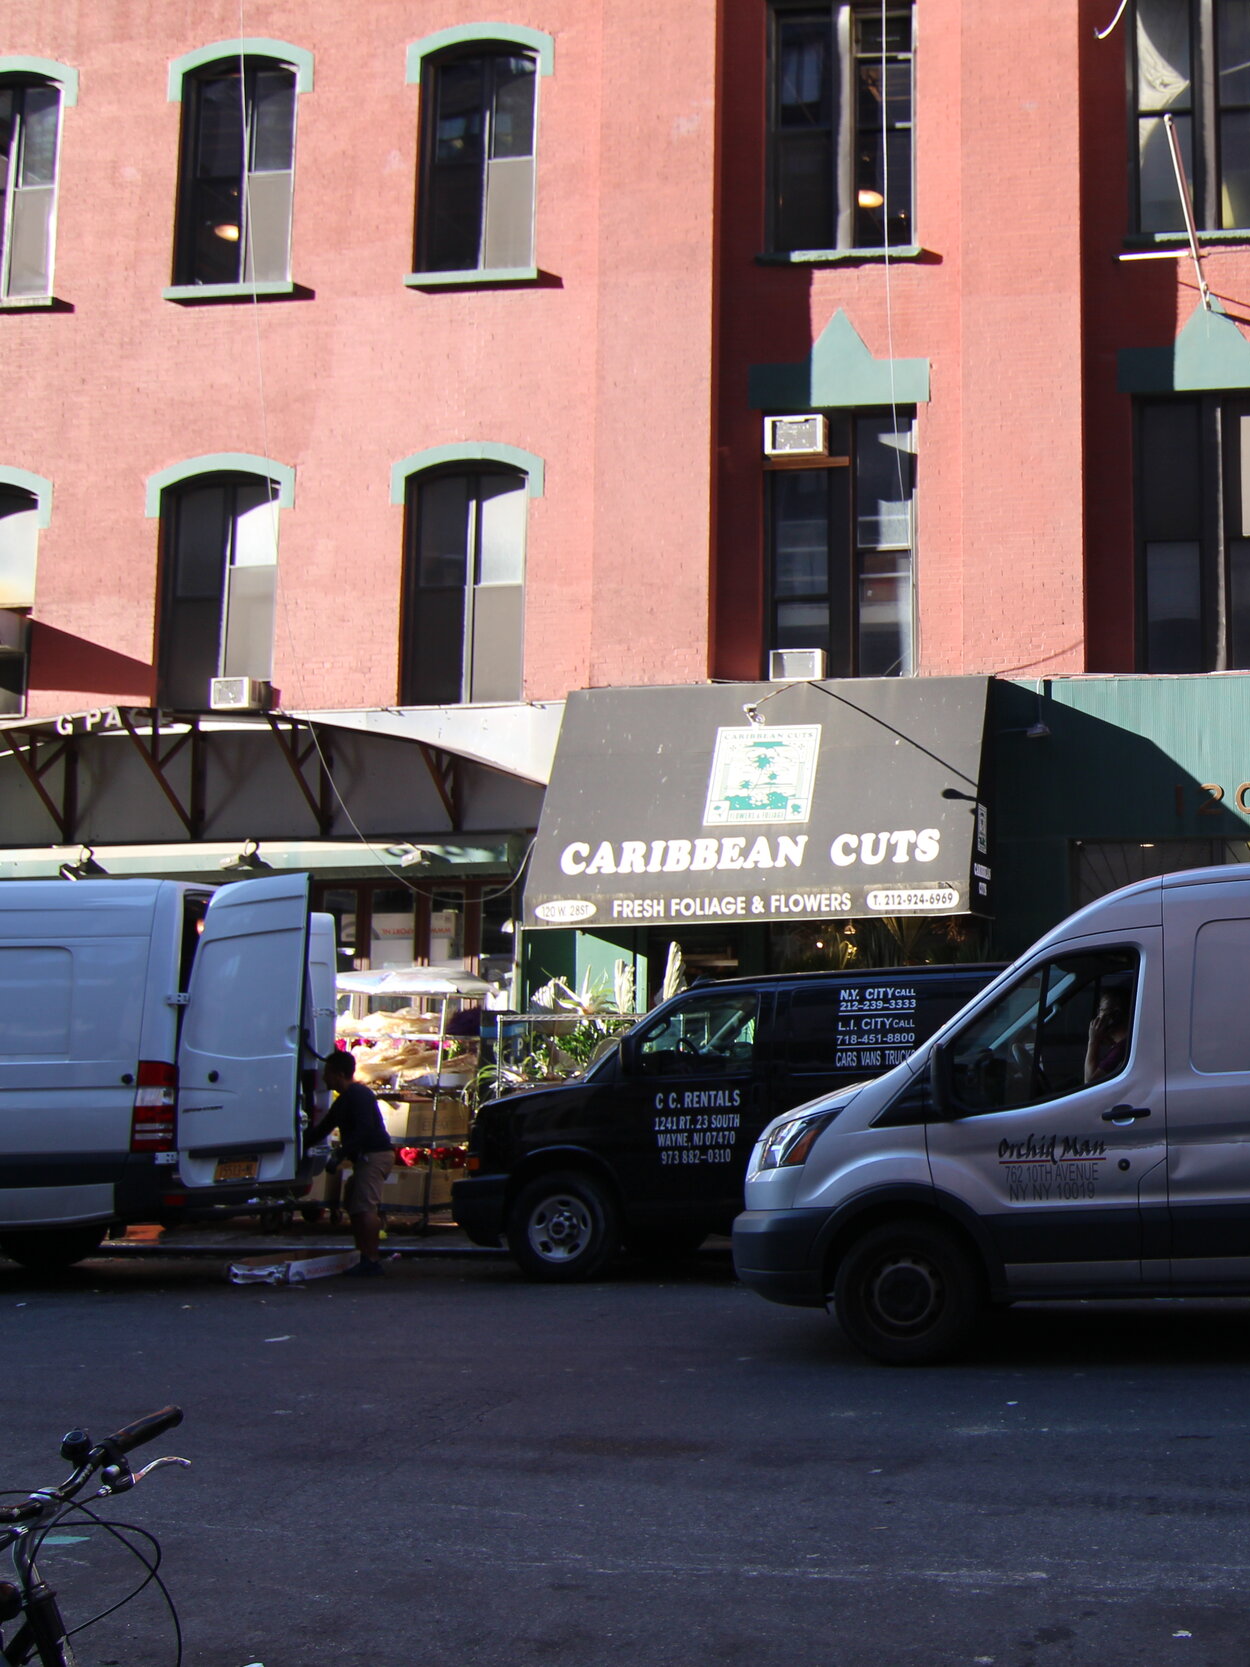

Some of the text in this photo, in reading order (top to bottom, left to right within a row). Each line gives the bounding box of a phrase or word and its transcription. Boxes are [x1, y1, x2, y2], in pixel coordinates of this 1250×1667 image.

[560, 828, 940, 875] CARIBBEAN CUTS
[613, 892, 851, 917] FRESH FOLIAGE & FLOWERS
[884, 892, 953, 906] 212-924-6969
[541, 905, 556, 917] 120
[570, 904, 589, 916] 28ST
[840, 987, 916, 1000] N.Y. CITY CALL
[839, 999, 917, 1011] 212-239-3333
[838, 1017, 915, 1031] L.I. CITY CALL
[836, 1032, 915, 1045] 718-451-8800
[835, 1051, 857, 1067] CARS
[861, 1050, 881, 1066] VANS
[684, 1089, 741, 1108] RENTALS
[654, 1113, 740, 1131] 1241 RT. 23 SOUTH
[657, 1130, 736, 1148] WAYNE, NJ 07470
[661, 1148, 732, 1165] 973 882-0310
[998, 1133, 1107, 1165] Orchid Man
[1005, 1162, 1099, 1183] 762 10TH AVENUE
[1010, 1181, 1095, 1202] NY NY 10019
